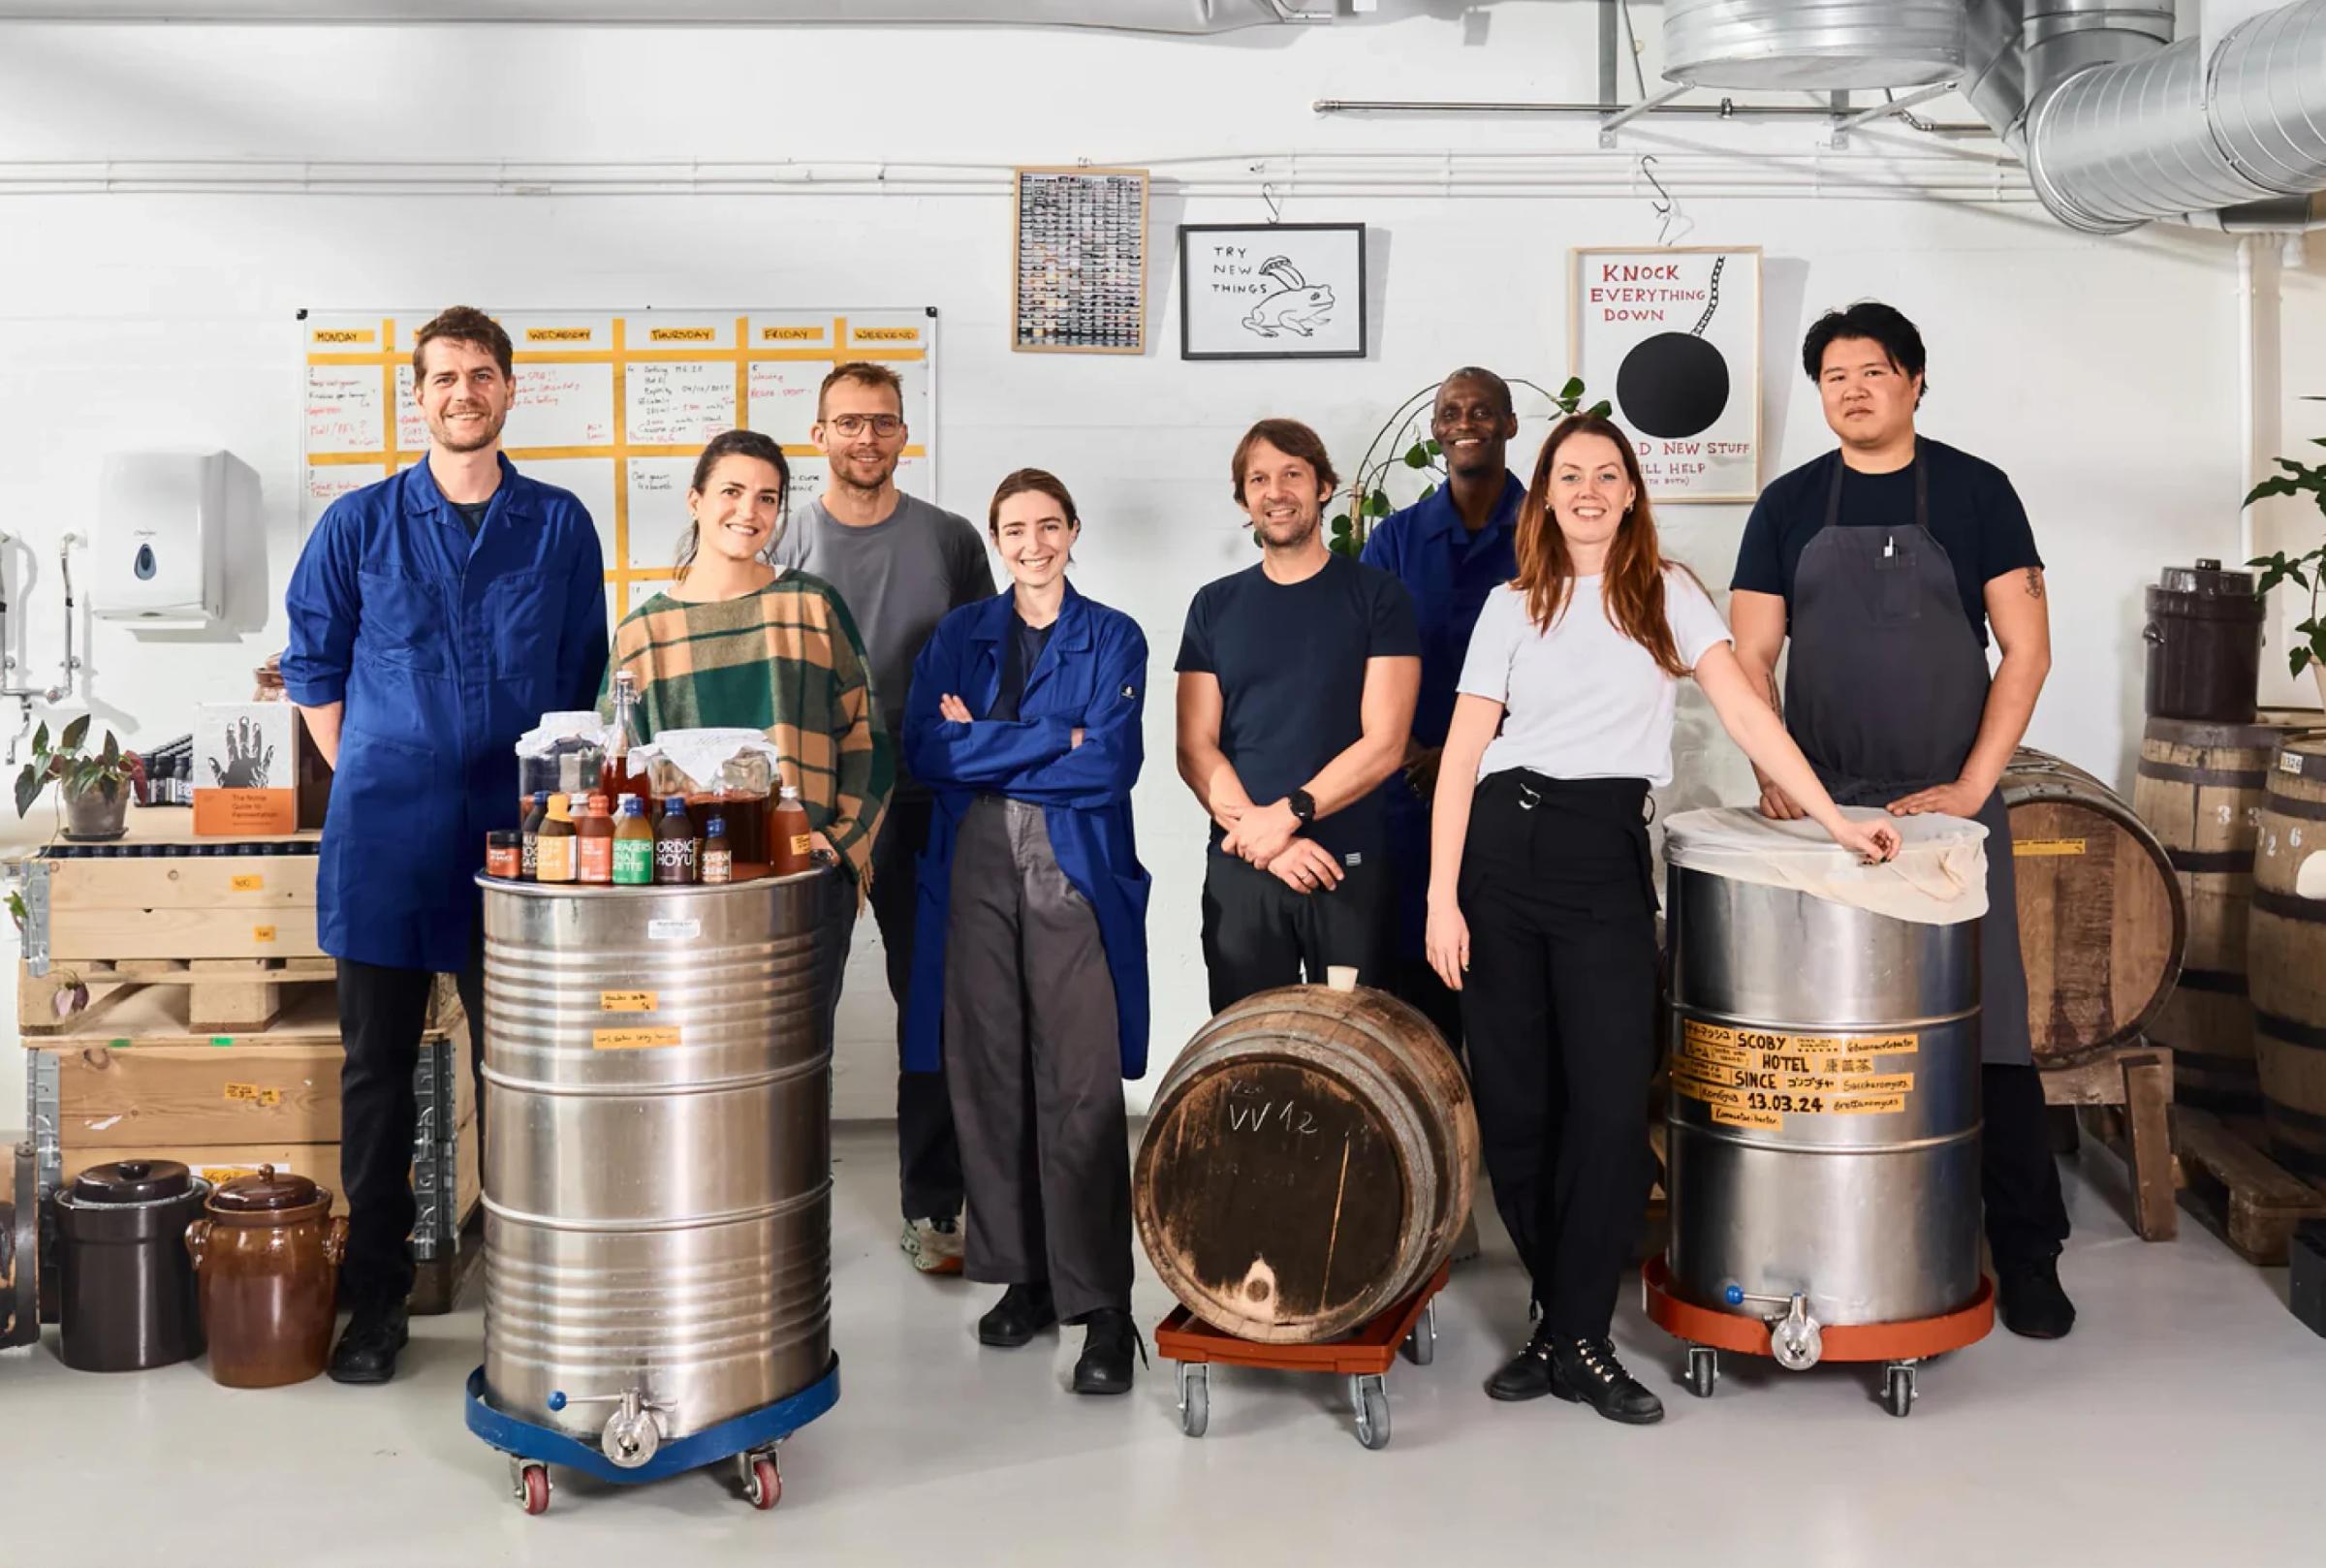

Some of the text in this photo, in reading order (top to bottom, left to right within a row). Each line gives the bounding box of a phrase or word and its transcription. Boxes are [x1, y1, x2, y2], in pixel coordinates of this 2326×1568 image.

[1213, 246, 1247, 258] TRY
[1213, 265, 1252, 275] NEW
[1602, 264, 1681, 282] KNOCK
[1211, 283, 1268, 294] THINGS
[1590, 288, 1706, 303] EVERYTHING
[1604, 308, 1664, 321] DOWN
[651, 329, 709, 340] THURSDAY
[764, 329, 807, 340] FRIDAY
[856, 329, 915, 340] WEEKEND
[1663, 442, 1701, 455] NEW
[1707, 442, 1750, 455] STUFF
[1640, 463, 1706, 475] ILL HELP
[656, 840, 694, 854] ORDIC
[656, 853, 693, 867] HOYU
[1738, 1032, 1786, 1051] SCOBY
[1762, 1054, 1810, 1074] HOTEL
[1735, 1070, 1777, 1089] SINCE
[1747, 1092, 1824, 1113] 13.03.24
[1278, 1100, 1318, 1134] 12
